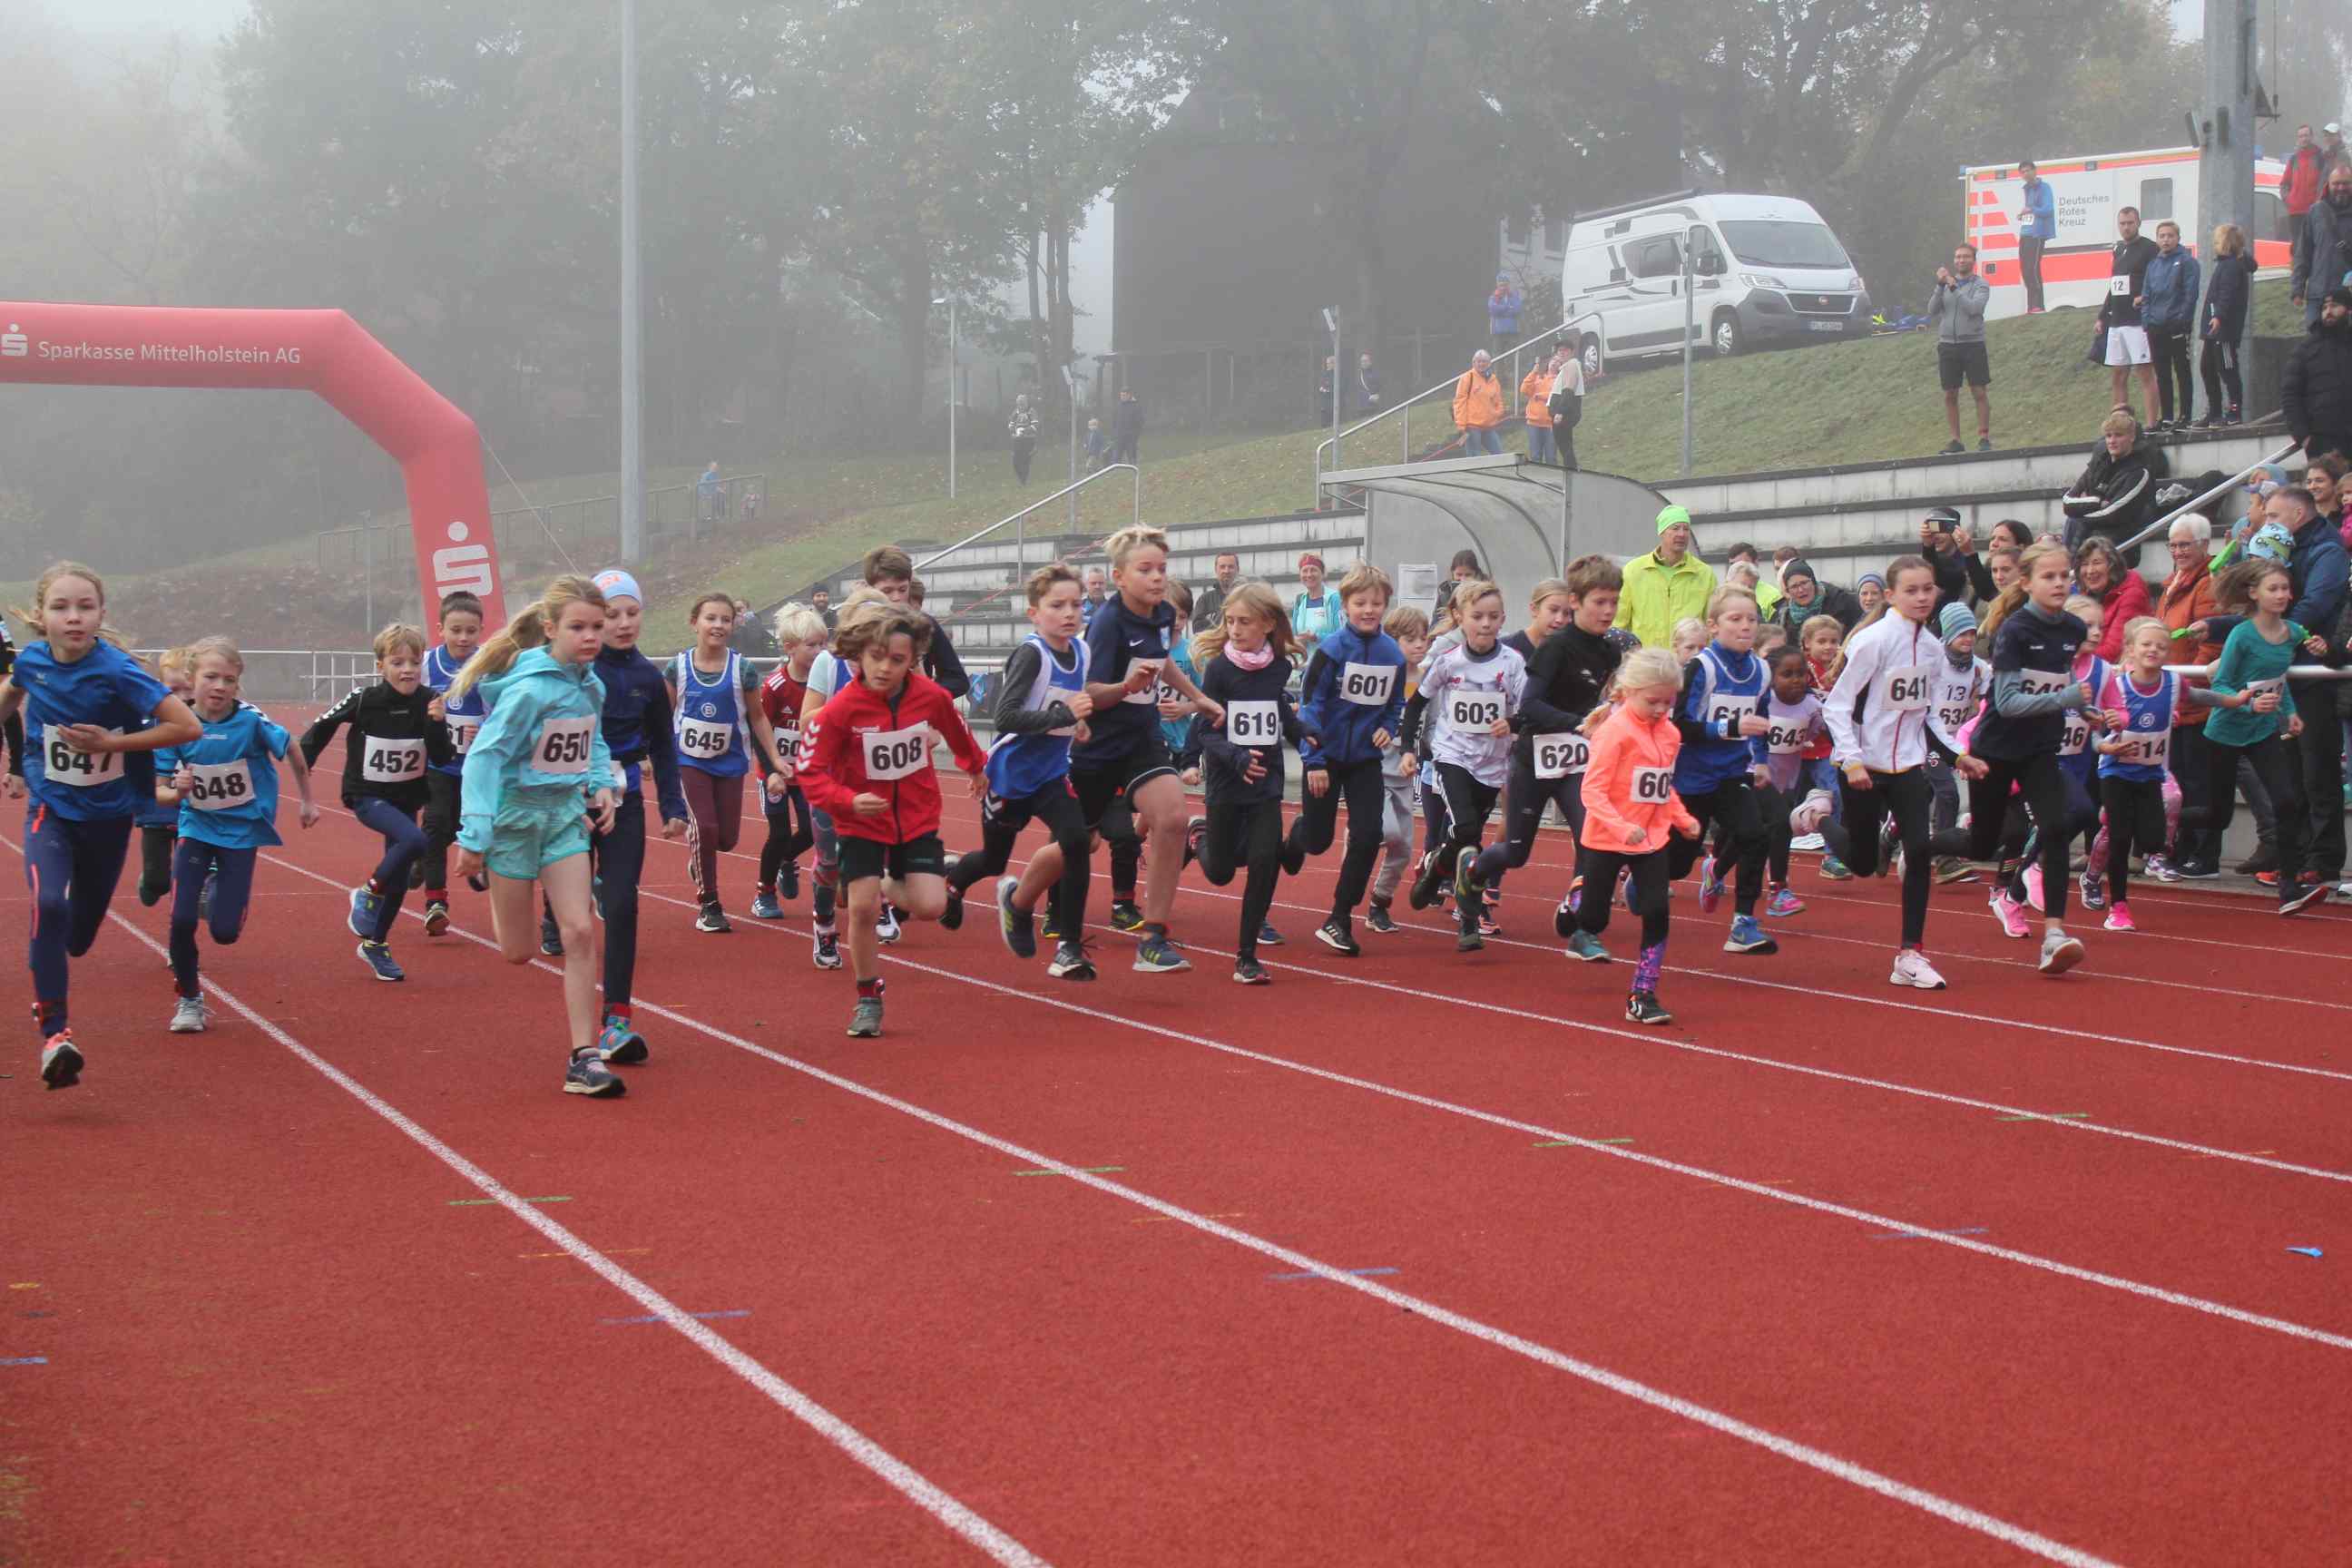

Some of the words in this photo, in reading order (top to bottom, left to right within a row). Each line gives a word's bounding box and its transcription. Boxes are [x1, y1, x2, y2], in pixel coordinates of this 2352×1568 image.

[2059, 194, 2110, 206] Deutsches
[2059, 207, 2087, 217] Rotes
[2059, 218, 2087, 227] Kreuz
[2113, 280, 2123, 291] 12
[38, 341, 134, 360] Sparkasse
[141, 344, 270, 363] Mittelholstein
[275, 348, 300, 363] AG
[1348, 673, 1388, 697] 601
[1890, 675, 1927, 701] 641
[1946, 685, 1967, 701] 13
[1454, 701, 1499, 724] 603
[1233, 712, 1277, 736] 619
[543, 730, 590, 762] 650
[684, 728, 725, 750] 645
[777, 738, 800, 757] 60
[1769, 726, 1807, 747] 643
[369, 750, 421, 773] 452
[871, 736, 923, 770] 608
[1540, 742, 1589, 769] 620
[192, 772, 247, 800] 648
